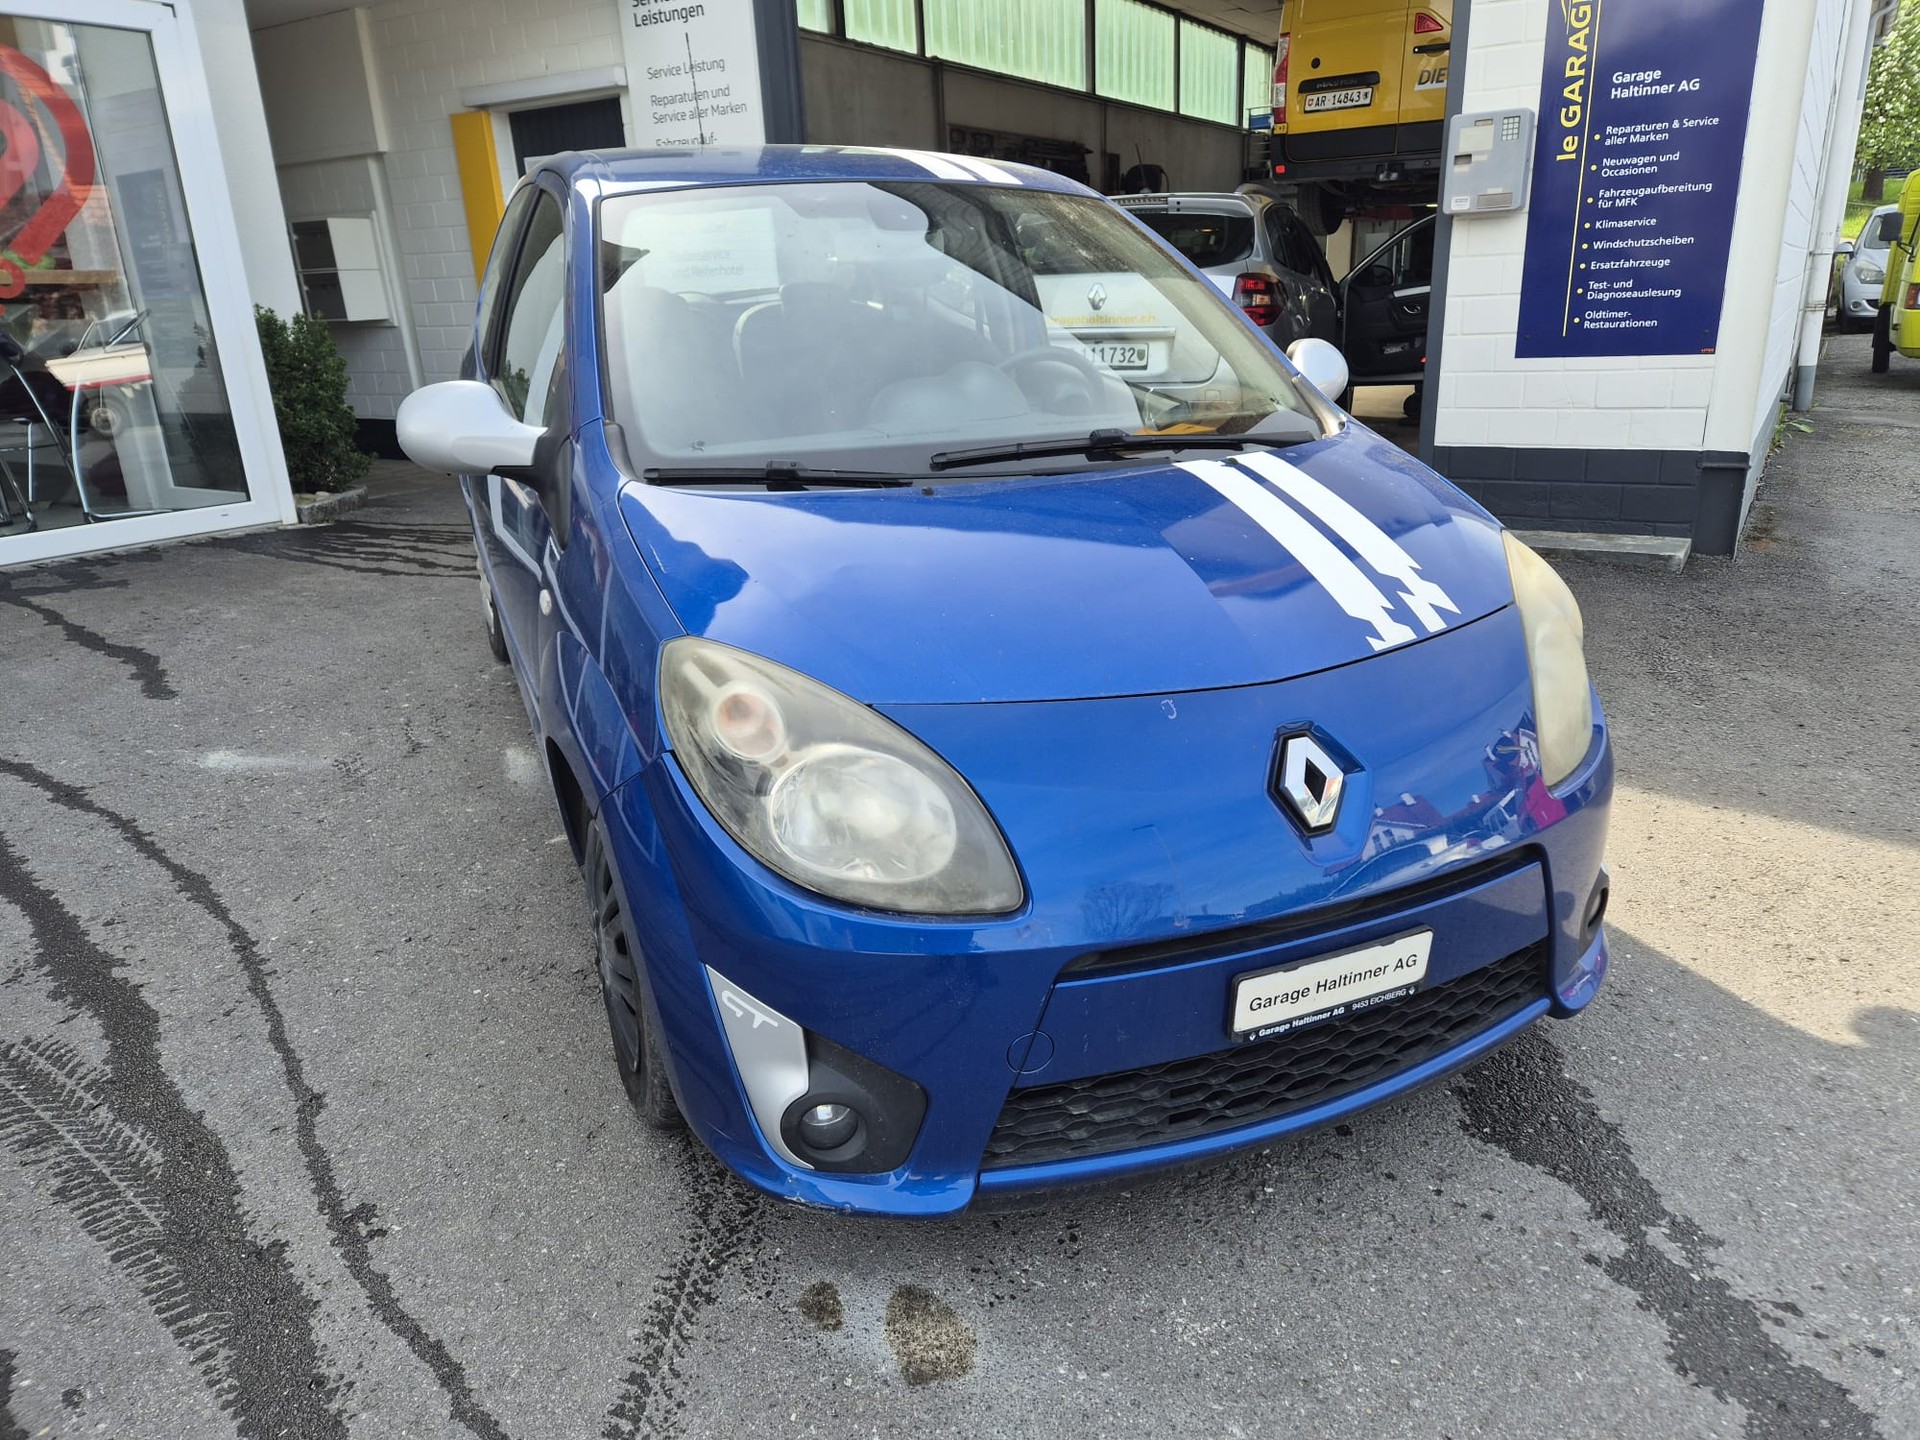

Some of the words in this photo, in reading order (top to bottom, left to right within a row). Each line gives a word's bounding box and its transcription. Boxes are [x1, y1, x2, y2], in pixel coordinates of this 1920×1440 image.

[633, 4, 705, 27] Leistungen
[647, 64, 681, 80] Service
[683, 58, 726, 75] Leistung
[1560, 0, 1592, 128] GARAG
[1612, 69, 1662, 84] Garage
[650, 89, 709, 108] Reparaturen
[711, 84, 731, 99] und
[1610, 82, 1675, 99] Haltinner
[1677, 79, 1701, 93] AG
[653, 109, 687, 124] Service
[688, 106, 709, 120] aller
[710, 102, 748, 117] Marken
[1606, 122, 1669, 136] Reparaturen
[1671, 119, 1680, 129] &
[1682, 116, 1720, 128] Service
[1604, 136, 1627, 146] aller
[1629, 132, 1669, 144] Marken
[1556, 135, 1579, 162] le
[1602, 155, 1657, 167] Neuwagen
[1659, 151, 1680, 162] und
[1601, 165, 1658, 178] Occasionen
[1598, 182, 1713, 199] Fahrzeugaufbereitung
[1597, 198, 1613, 209] für
[1615, 197, 1638, 208] MFK
[1595, 217, 1657, 230] Klimaservice
[1593, 236, 1695, 250] Windschutzscheiben
[1590, 258, 1671, 271] Ersatzfahrzeuge
[1588, 281, 1611, 290] Test-
[1613, 279, 1633, 289] und
[1587, 288, 1682, 301] Diagnoseauslesung
[1585, 310, 1632, 320] Oldtimer-
[1583, 319, 1658, 330] Restaurationen
[1249, 986, 1310, 1012] Garage
[1315, 964, 1390, 994] Haltinner
[1393, 953, 1417, 973] AG
[1258, 1020, 1291, 1038] Garage
[1292, 1011, 1331, 1028] Haltinner
[1332, 1006, 1345, 1019] AG
[1352, 1000, 1369, 1011] 9453
[1370, 989, 1407, 1006] EICHBERG
